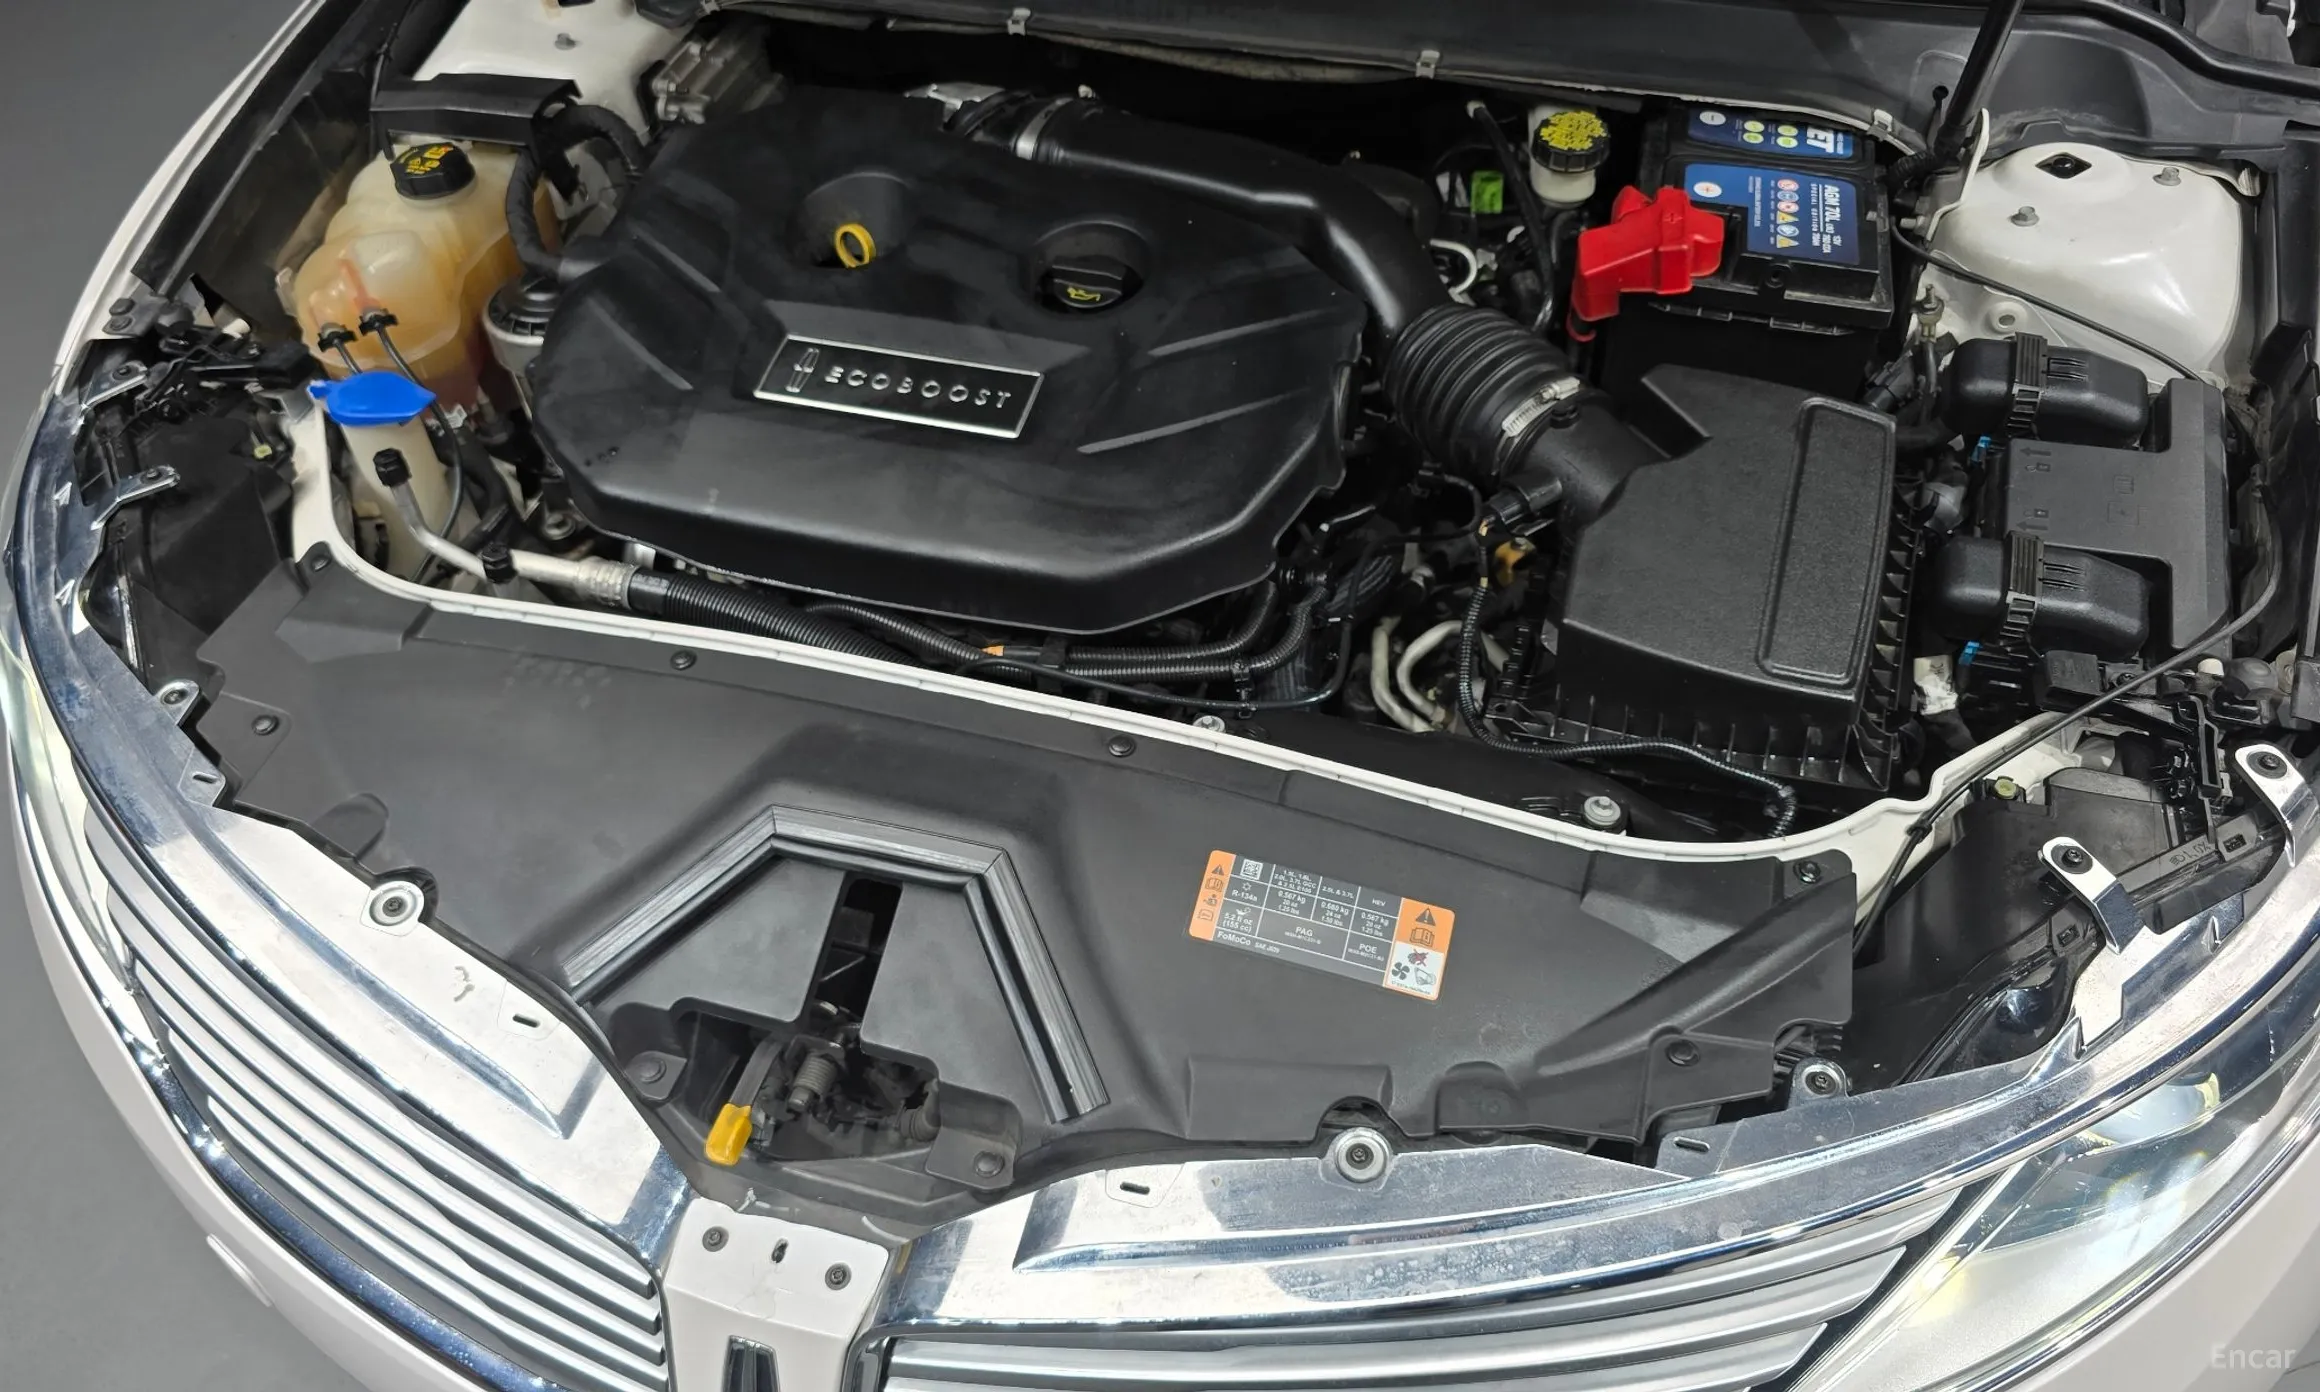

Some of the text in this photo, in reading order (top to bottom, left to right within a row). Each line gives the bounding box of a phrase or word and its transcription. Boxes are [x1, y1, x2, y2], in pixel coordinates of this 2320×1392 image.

[1824, 184, 1840, 205] AGM
[825, 365, 1012, 408] ECOBOOST
[1232, 889, 1258, 902] R-134a
[1297, 894, 1306, 904] kg
[1340, 905, 1349, 916] kg
[1224, 912, 1235, 921] 5.2
[1379, 915, 1389, 926] kg
[1222, 920, 1252, 933] (155 cc)
[1295, 926, 1313, 937] PAG
[1217, 930, 1251, 946] FoMoCo
[1359, 943, 1378, 954] POE
